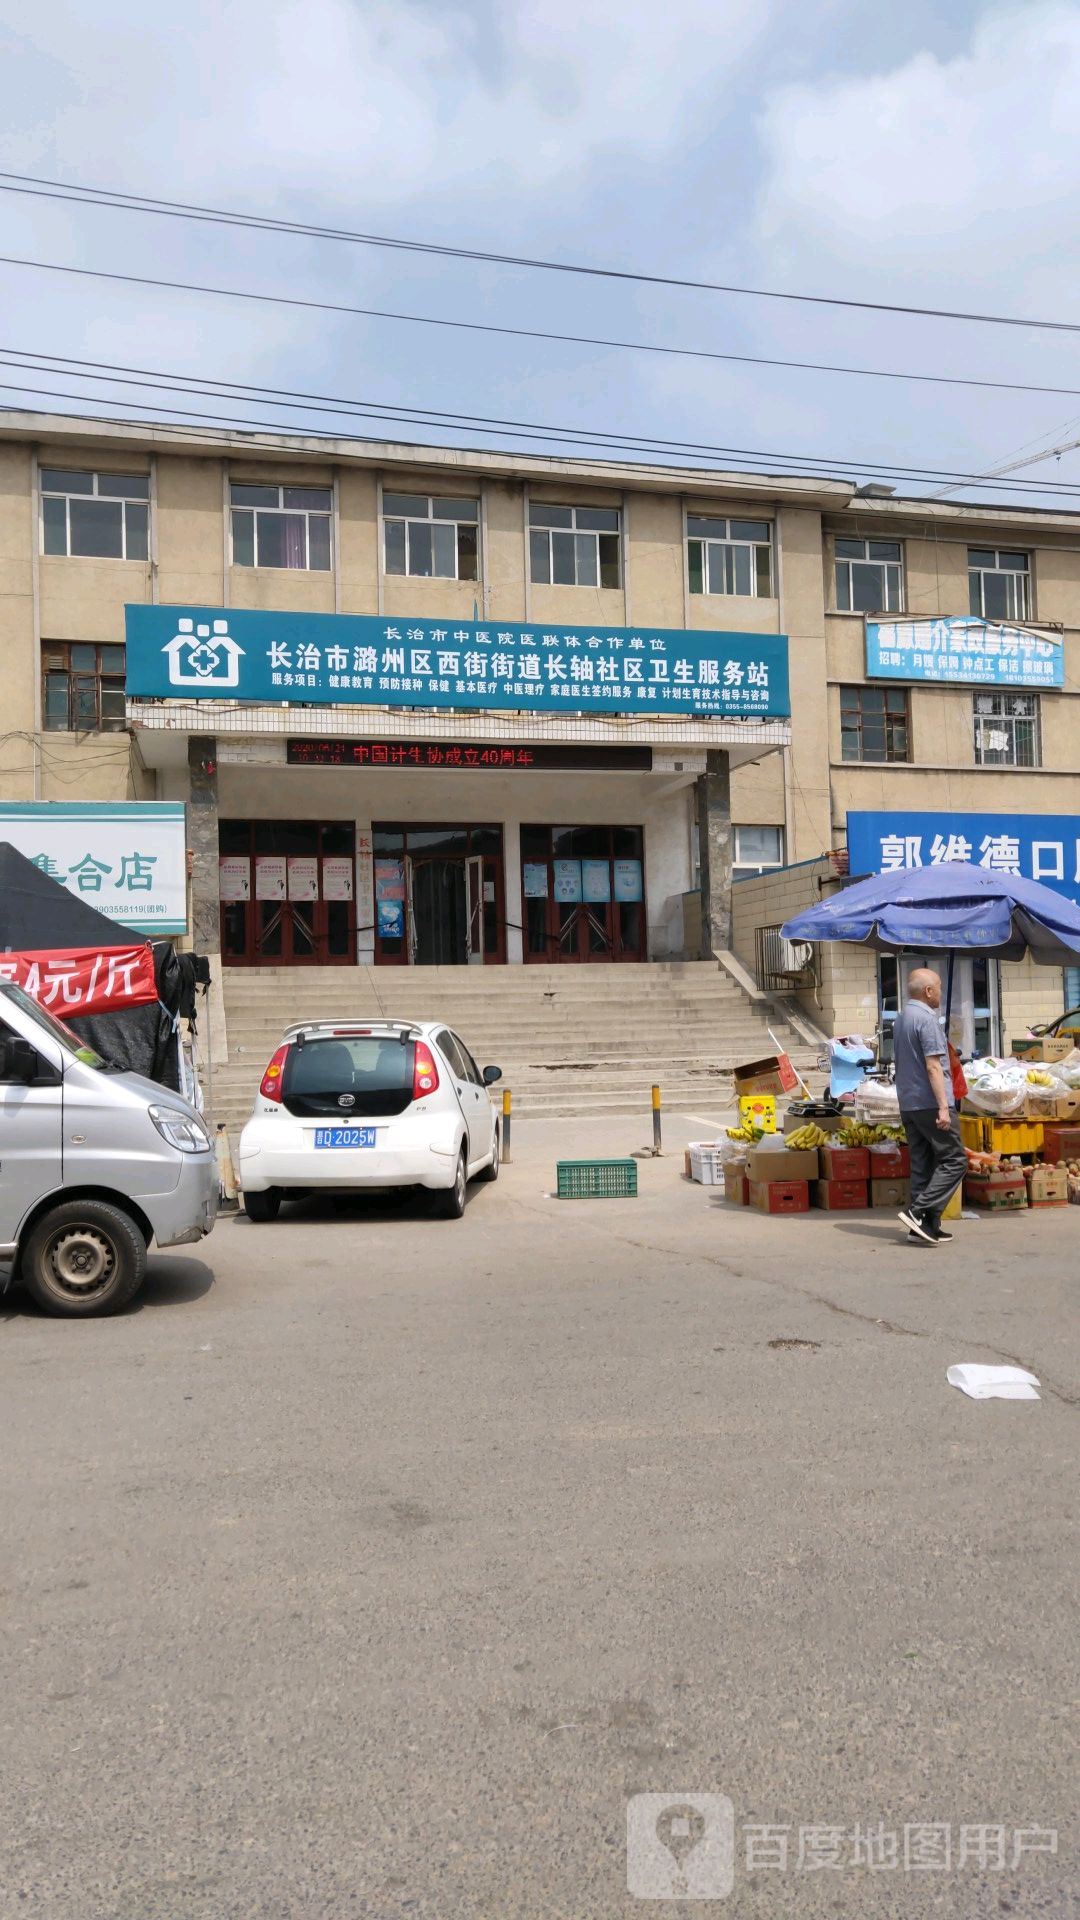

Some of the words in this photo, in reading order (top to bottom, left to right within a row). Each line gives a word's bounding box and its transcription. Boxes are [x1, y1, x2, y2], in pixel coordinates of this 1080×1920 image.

[383, 626, 668, 651] 长治市中医院医联体合作单位
[266, 641, 769, 687] 长治市潞州区西街街道长轴社区卫生服务站
[329, 674, 373, 689] 健康教育
[379, 676, 423, 691] 预防接种
[428, 678, 449, 693] 保健
[455, 679, 498, 695] 基本医疗
[503, 682, 545, 696] 中医理疗
[550, 684, 632, 699] 家庭医生签约服务
[637, 686, 657, 699] 康复
[662, 686, 770, 702] 计划生育技术指导与咨询
[352, 745, 534, 766] 中国计生协成立40周年
[880, 834, 1080, 884] 郭维德口
